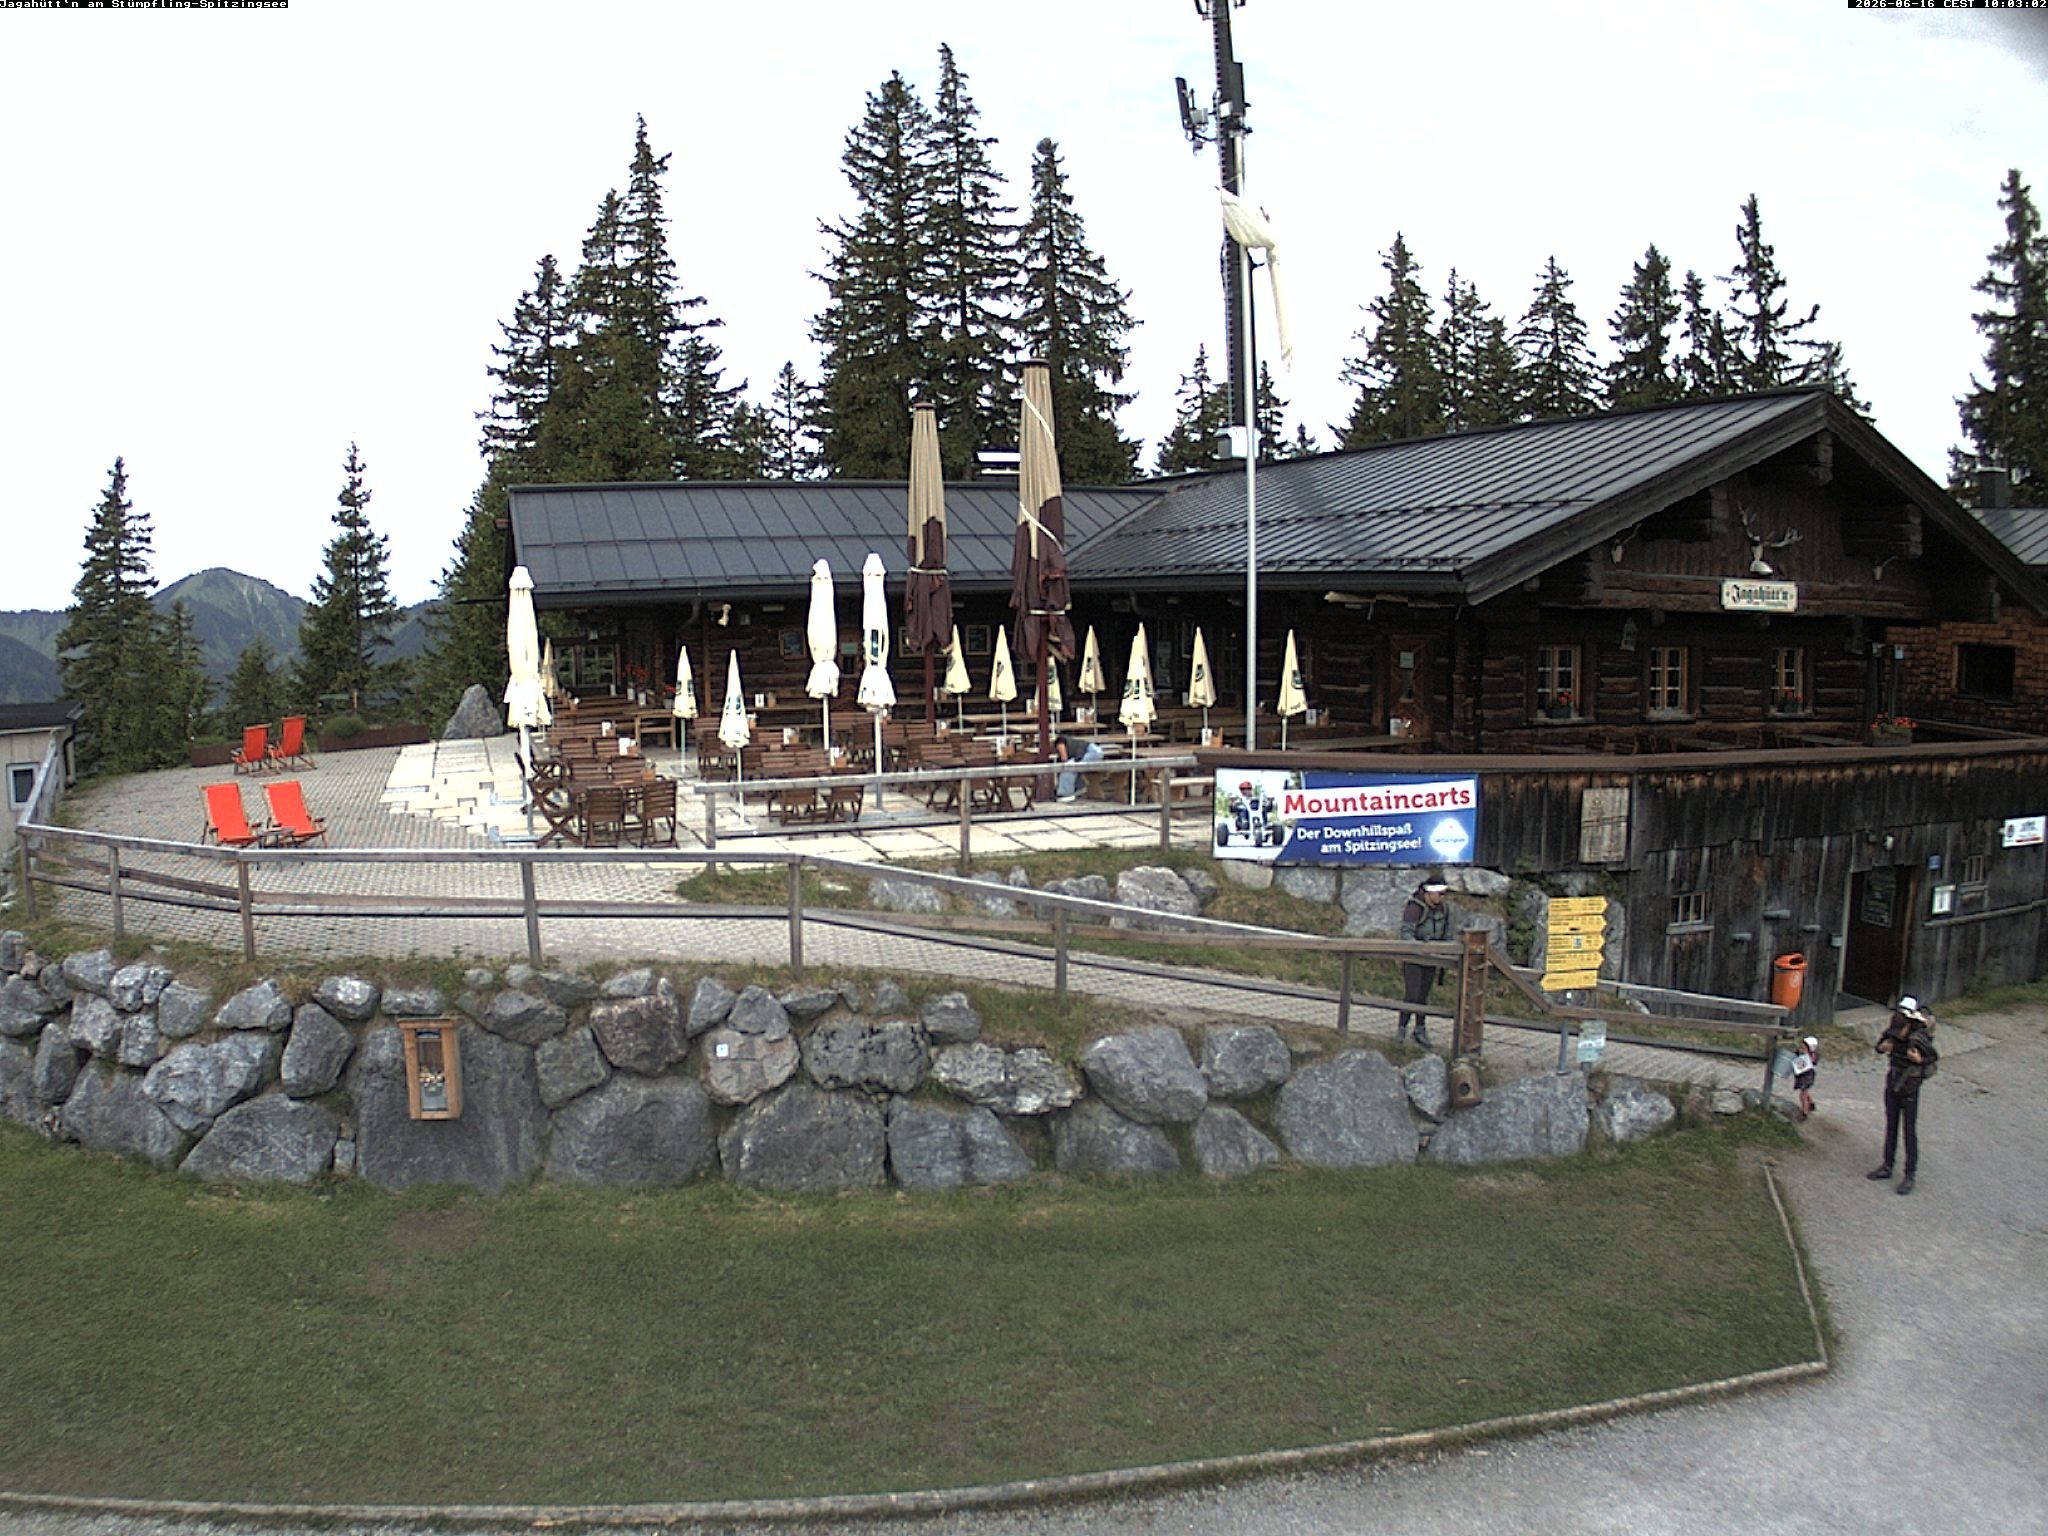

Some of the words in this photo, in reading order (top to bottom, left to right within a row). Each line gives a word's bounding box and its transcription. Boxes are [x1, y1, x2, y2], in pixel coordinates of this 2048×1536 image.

[1284, 787, 1470, 814] Mountaincarts
[1297, 827, 1320, 839] Der
[1324, 823, 1412, 838] Downhillspaß
[1321, 843, 1342, 854] am
[1345, 837, 1421, 853] Spitzingsee!
